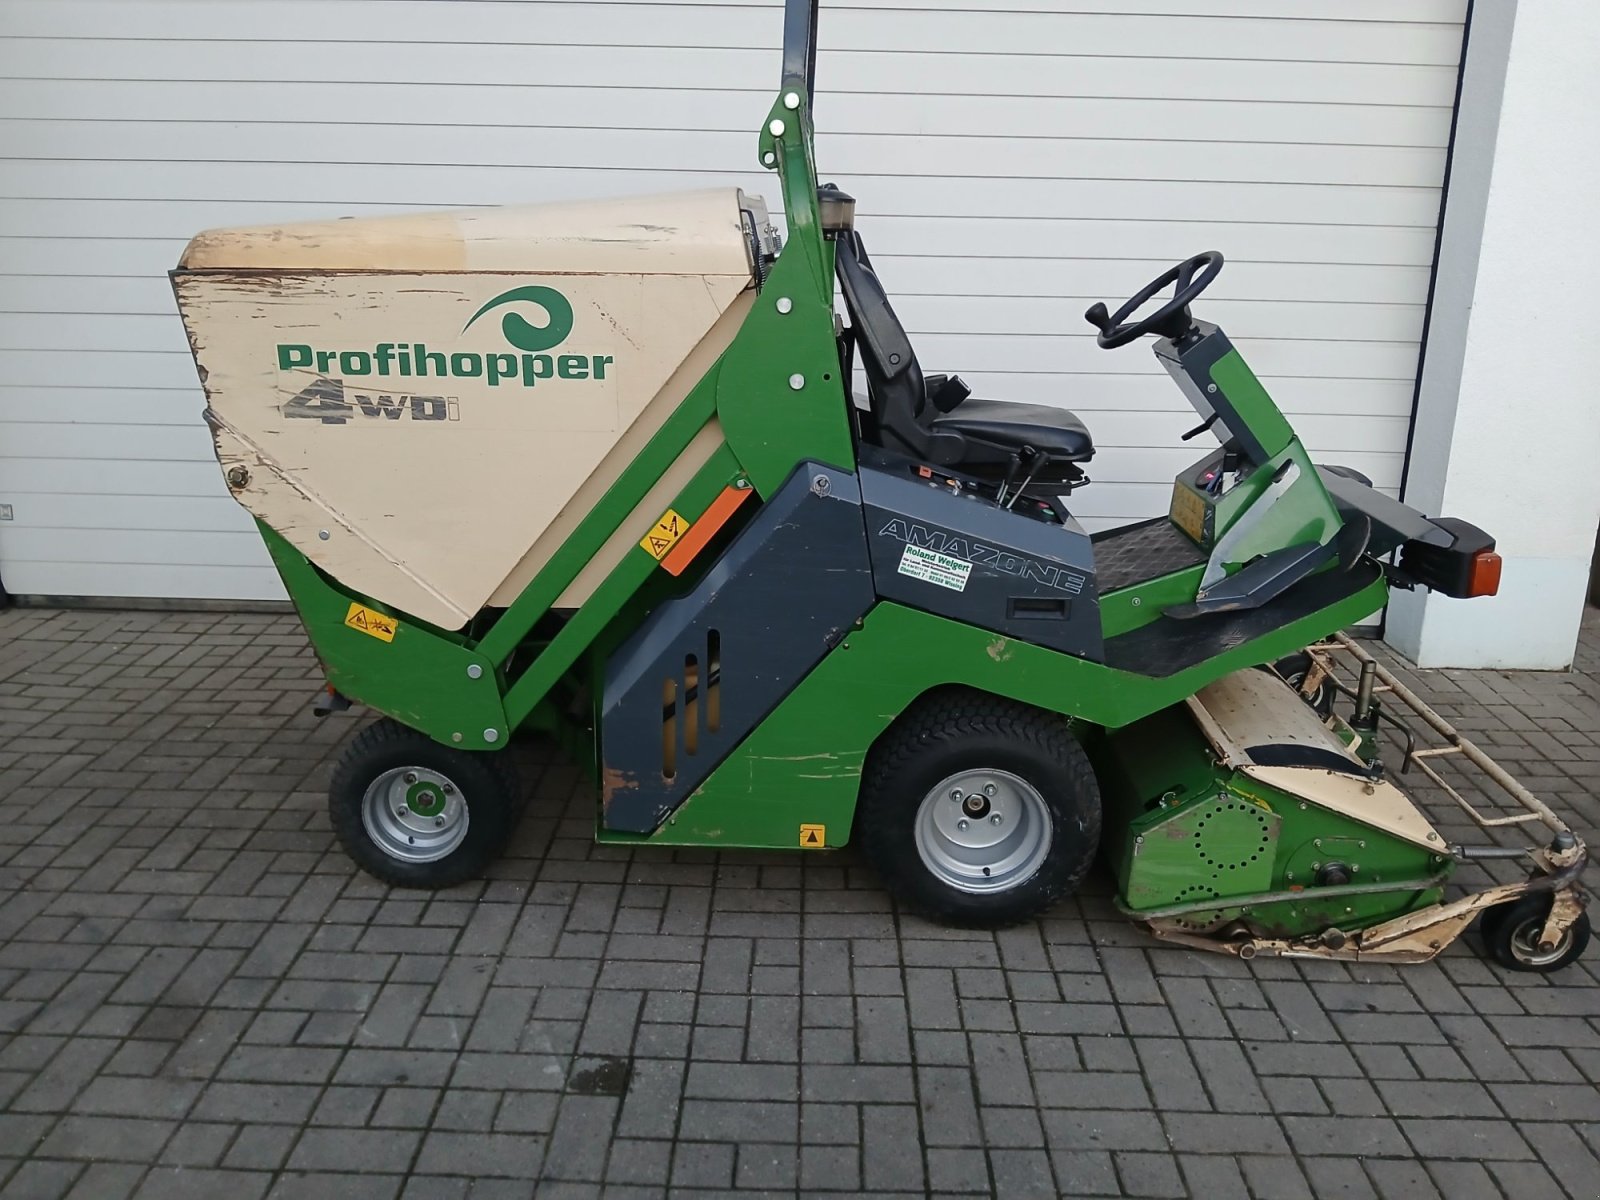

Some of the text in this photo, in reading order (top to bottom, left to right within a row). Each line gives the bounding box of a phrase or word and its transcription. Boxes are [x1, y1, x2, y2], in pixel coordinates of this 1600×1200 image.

[276, 343, 613, 386] Profihopper
[878, 518, 1085, 594] AMAZONE
[906, 546, 936, 561] Roland
